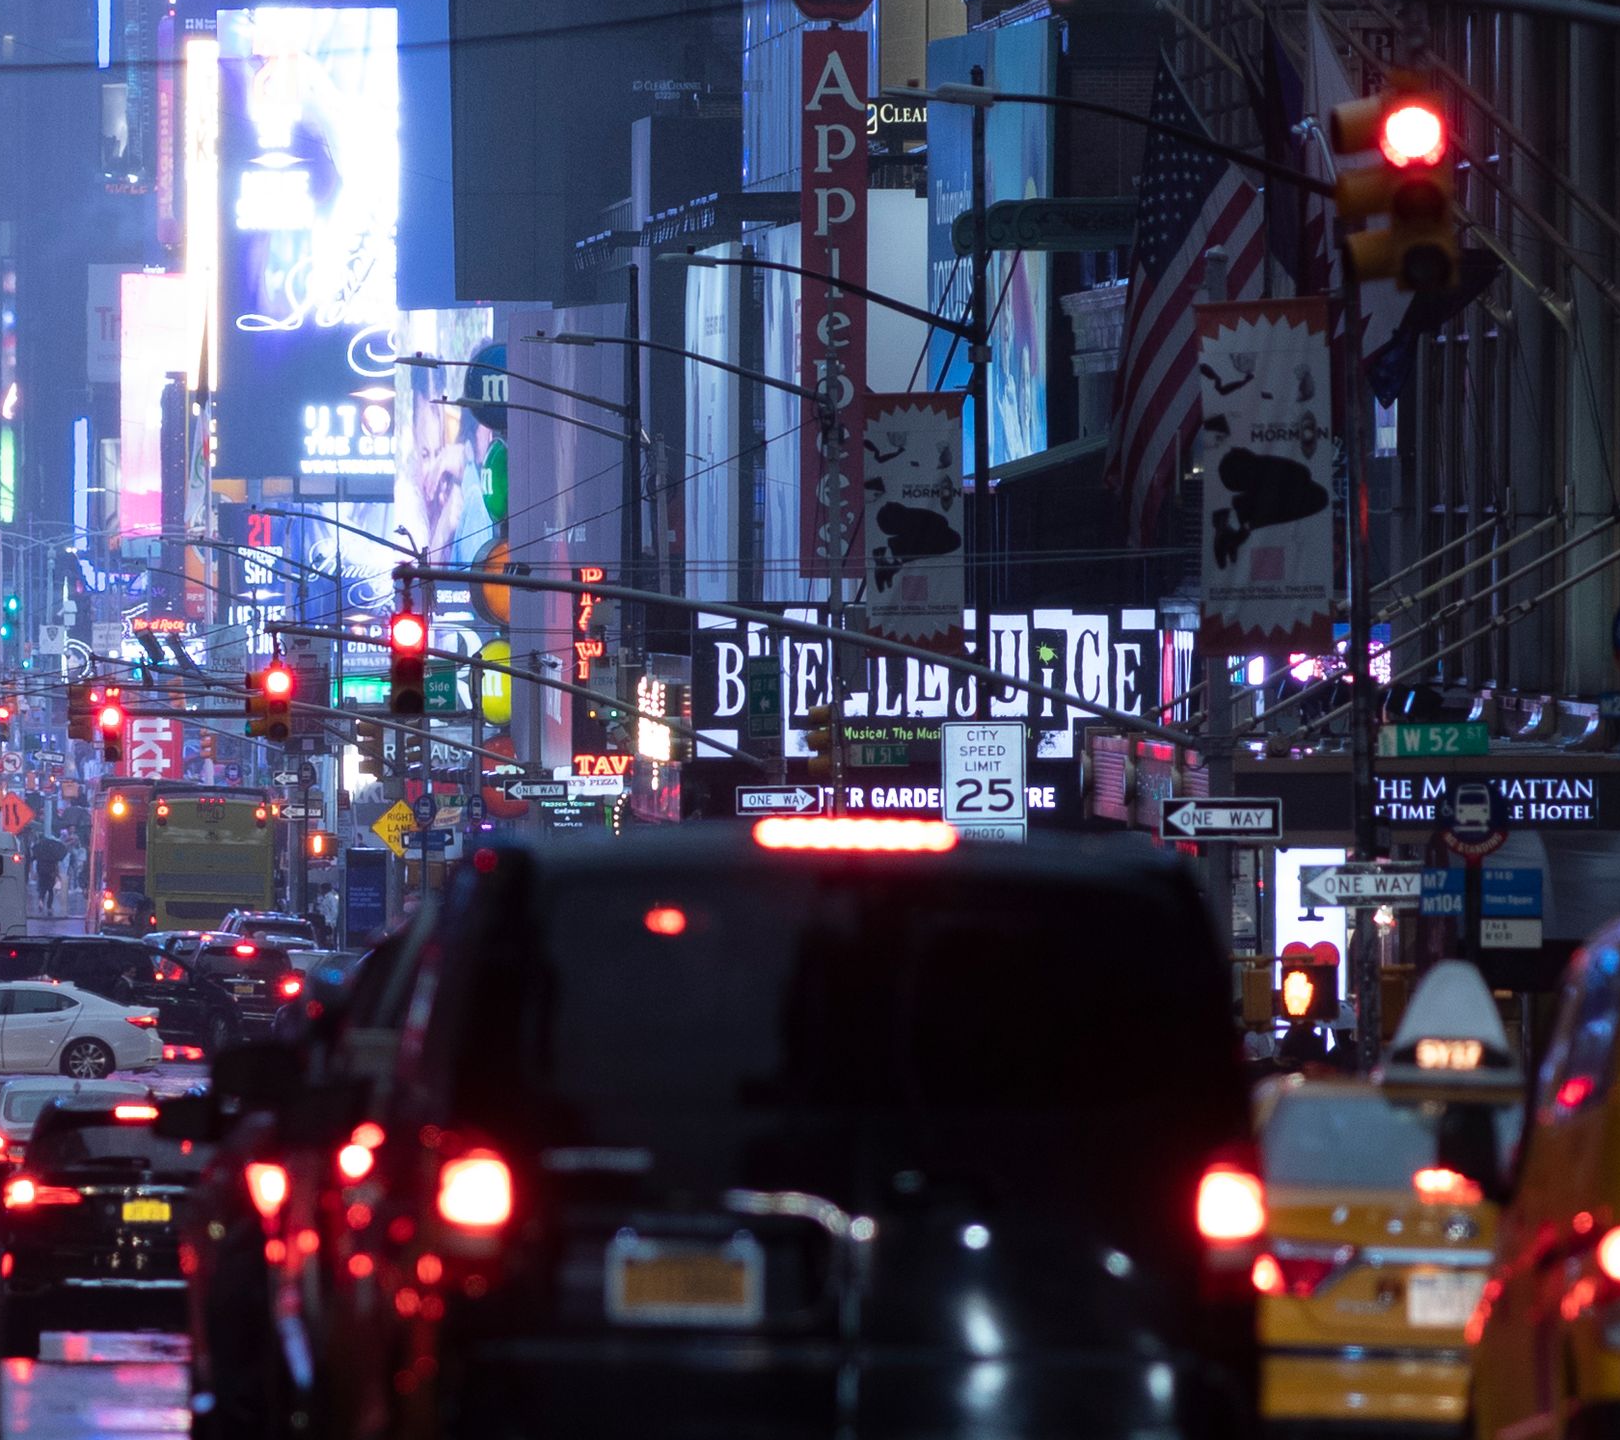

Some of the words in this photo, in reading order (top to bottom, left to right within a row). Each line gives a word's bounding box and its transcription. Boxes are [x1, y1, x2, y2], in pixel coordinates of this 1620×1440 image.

[805, 51, 866, 560] Applebee's
[1251, 426, 1329, 442] MORMON
[902, 488, 962, 499] MORMON
[247, 513, 271, 547] 21
[429, 682, 450, 693] Side
[916, 727, 942, 740] Musi
[966, 730, 999, 741] CITY
[1403, 728, 1423, 751] W
[1429, 727, 1460, 752] 52
[1466, 727, 1485, 740] ST
[131, 717, 173, 780] tkt
[865, 748, 876, 763] W
[959, 745, 1006, 756] SPEED
[574, 754, 630, 776] TAV
[964, 761, 1002, 772] LIMIT
[515, 786, 535, 795] ONE
[539, 786, 561, 795] WAY
[955, 778, 1015, 813] 25
[1422, 774, 1594, 800] MATTAN
[748, 795, 772, 805] ONE
[783, 795, 807, 805] WAY
[871, 787, 945, 808] GARDE
[1180, 811, 1213, 826] ONE
[1229, 811, 1265, 826] WAY
[1388, 804, 1436, 821] TIME
[1530, 802, 1594, 821] HOTEL
[964, 828, 1006, 840] PHOTO
[1324, 876, 1363, 894] ONE
[1373, 876, 1416, 894] WAY
[1422, 870, 1448, 888] M7
[1422, 893, 1463, 915] M104
